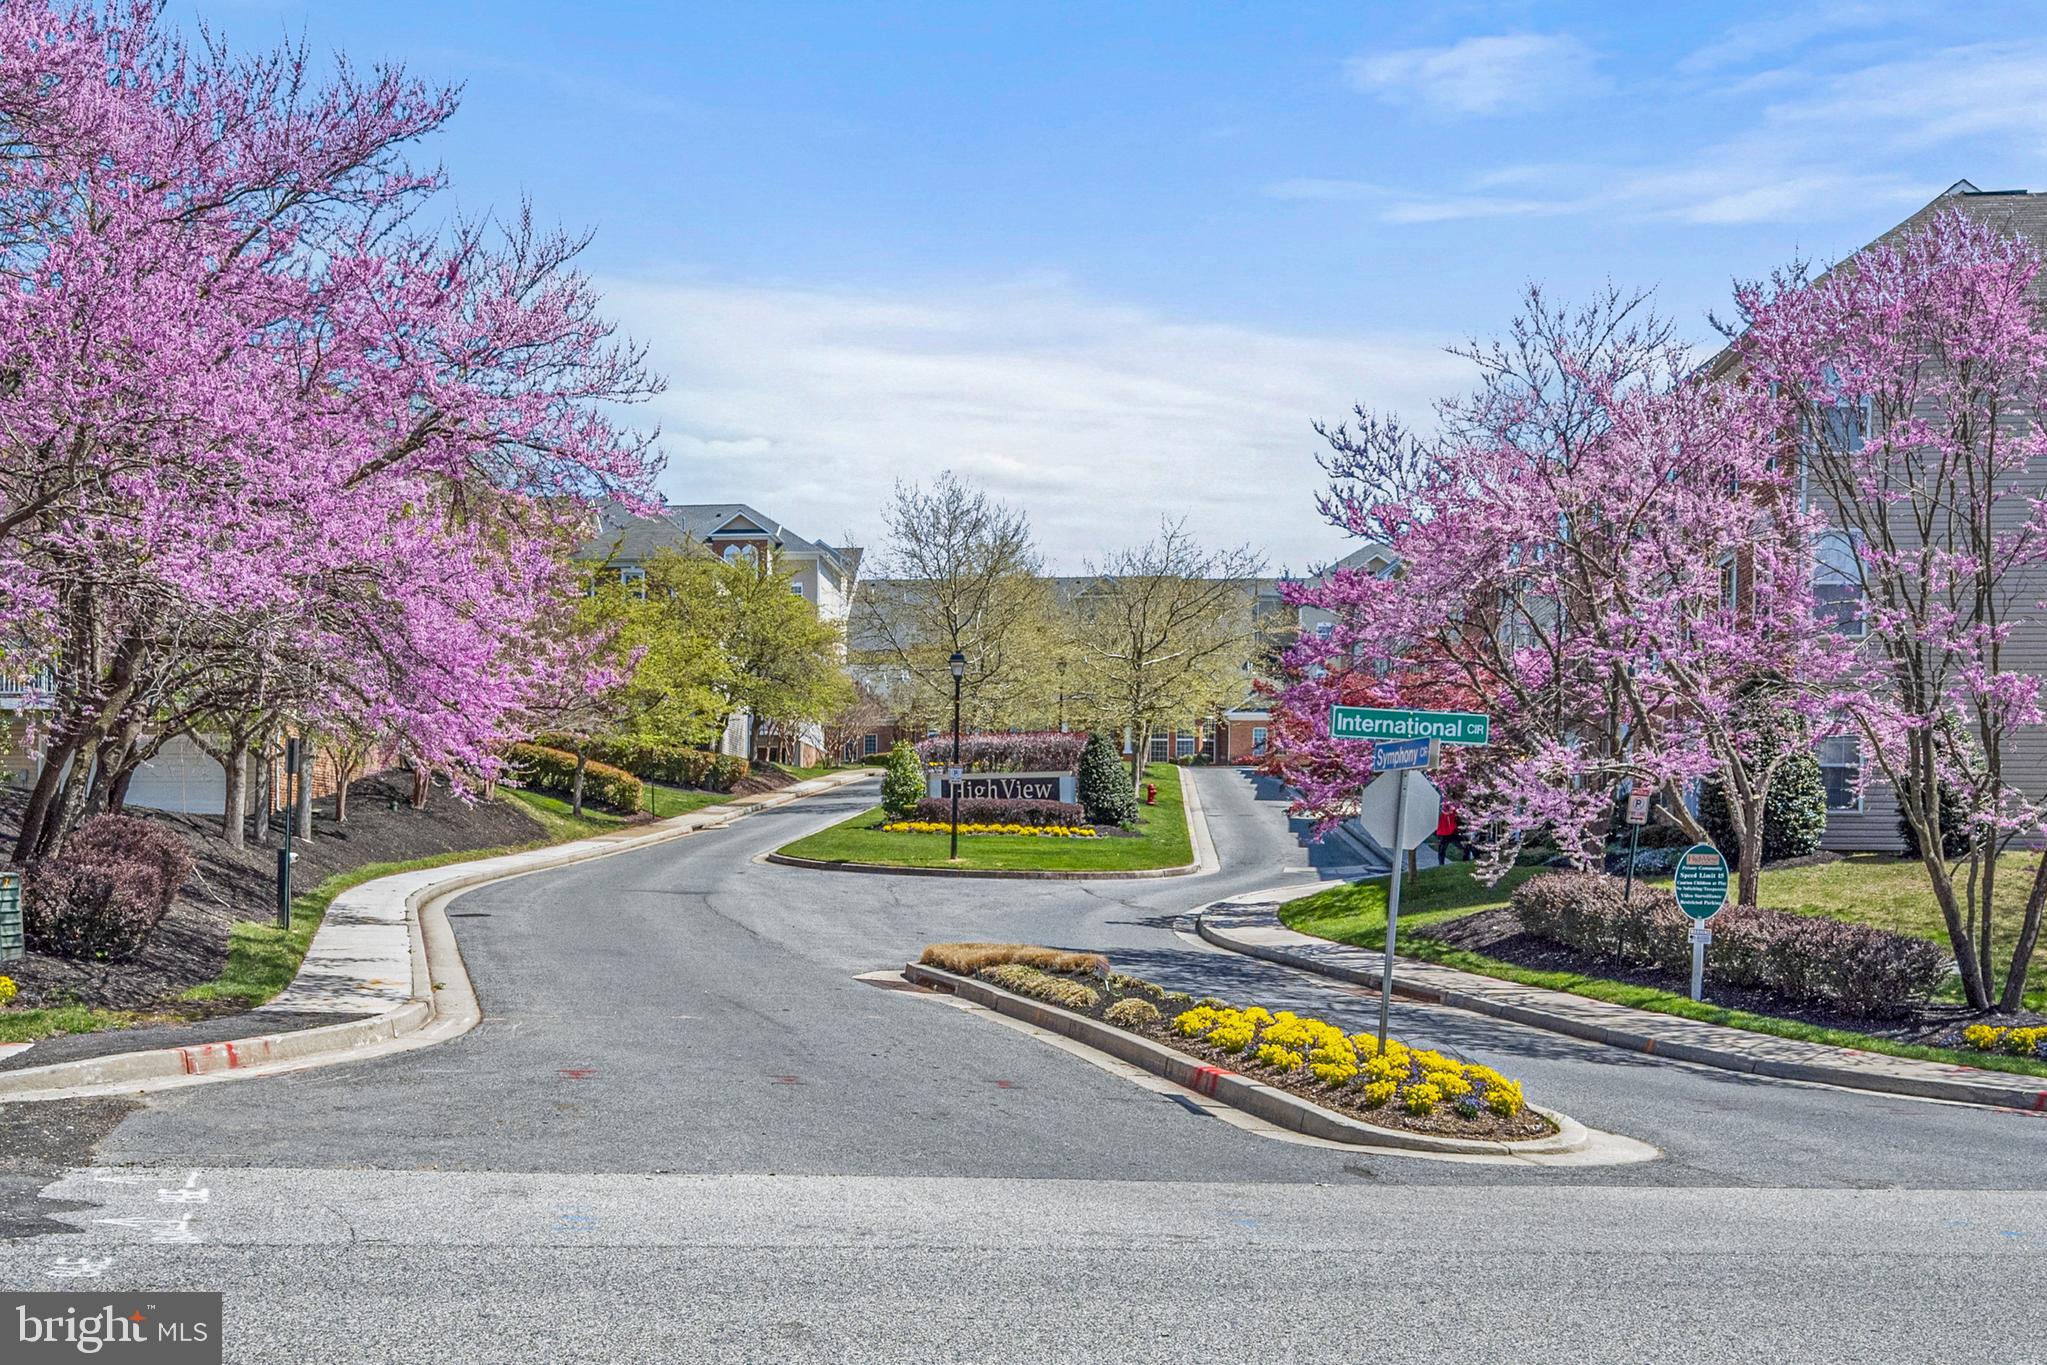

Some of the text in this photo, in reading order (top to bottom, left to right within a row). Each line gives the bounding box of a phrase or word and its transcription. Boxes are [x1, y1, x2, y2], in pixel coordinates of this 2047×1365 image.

[1337, 713, 1484, 737] International CIR
[1376, 747, 1419, 770] Symphony
